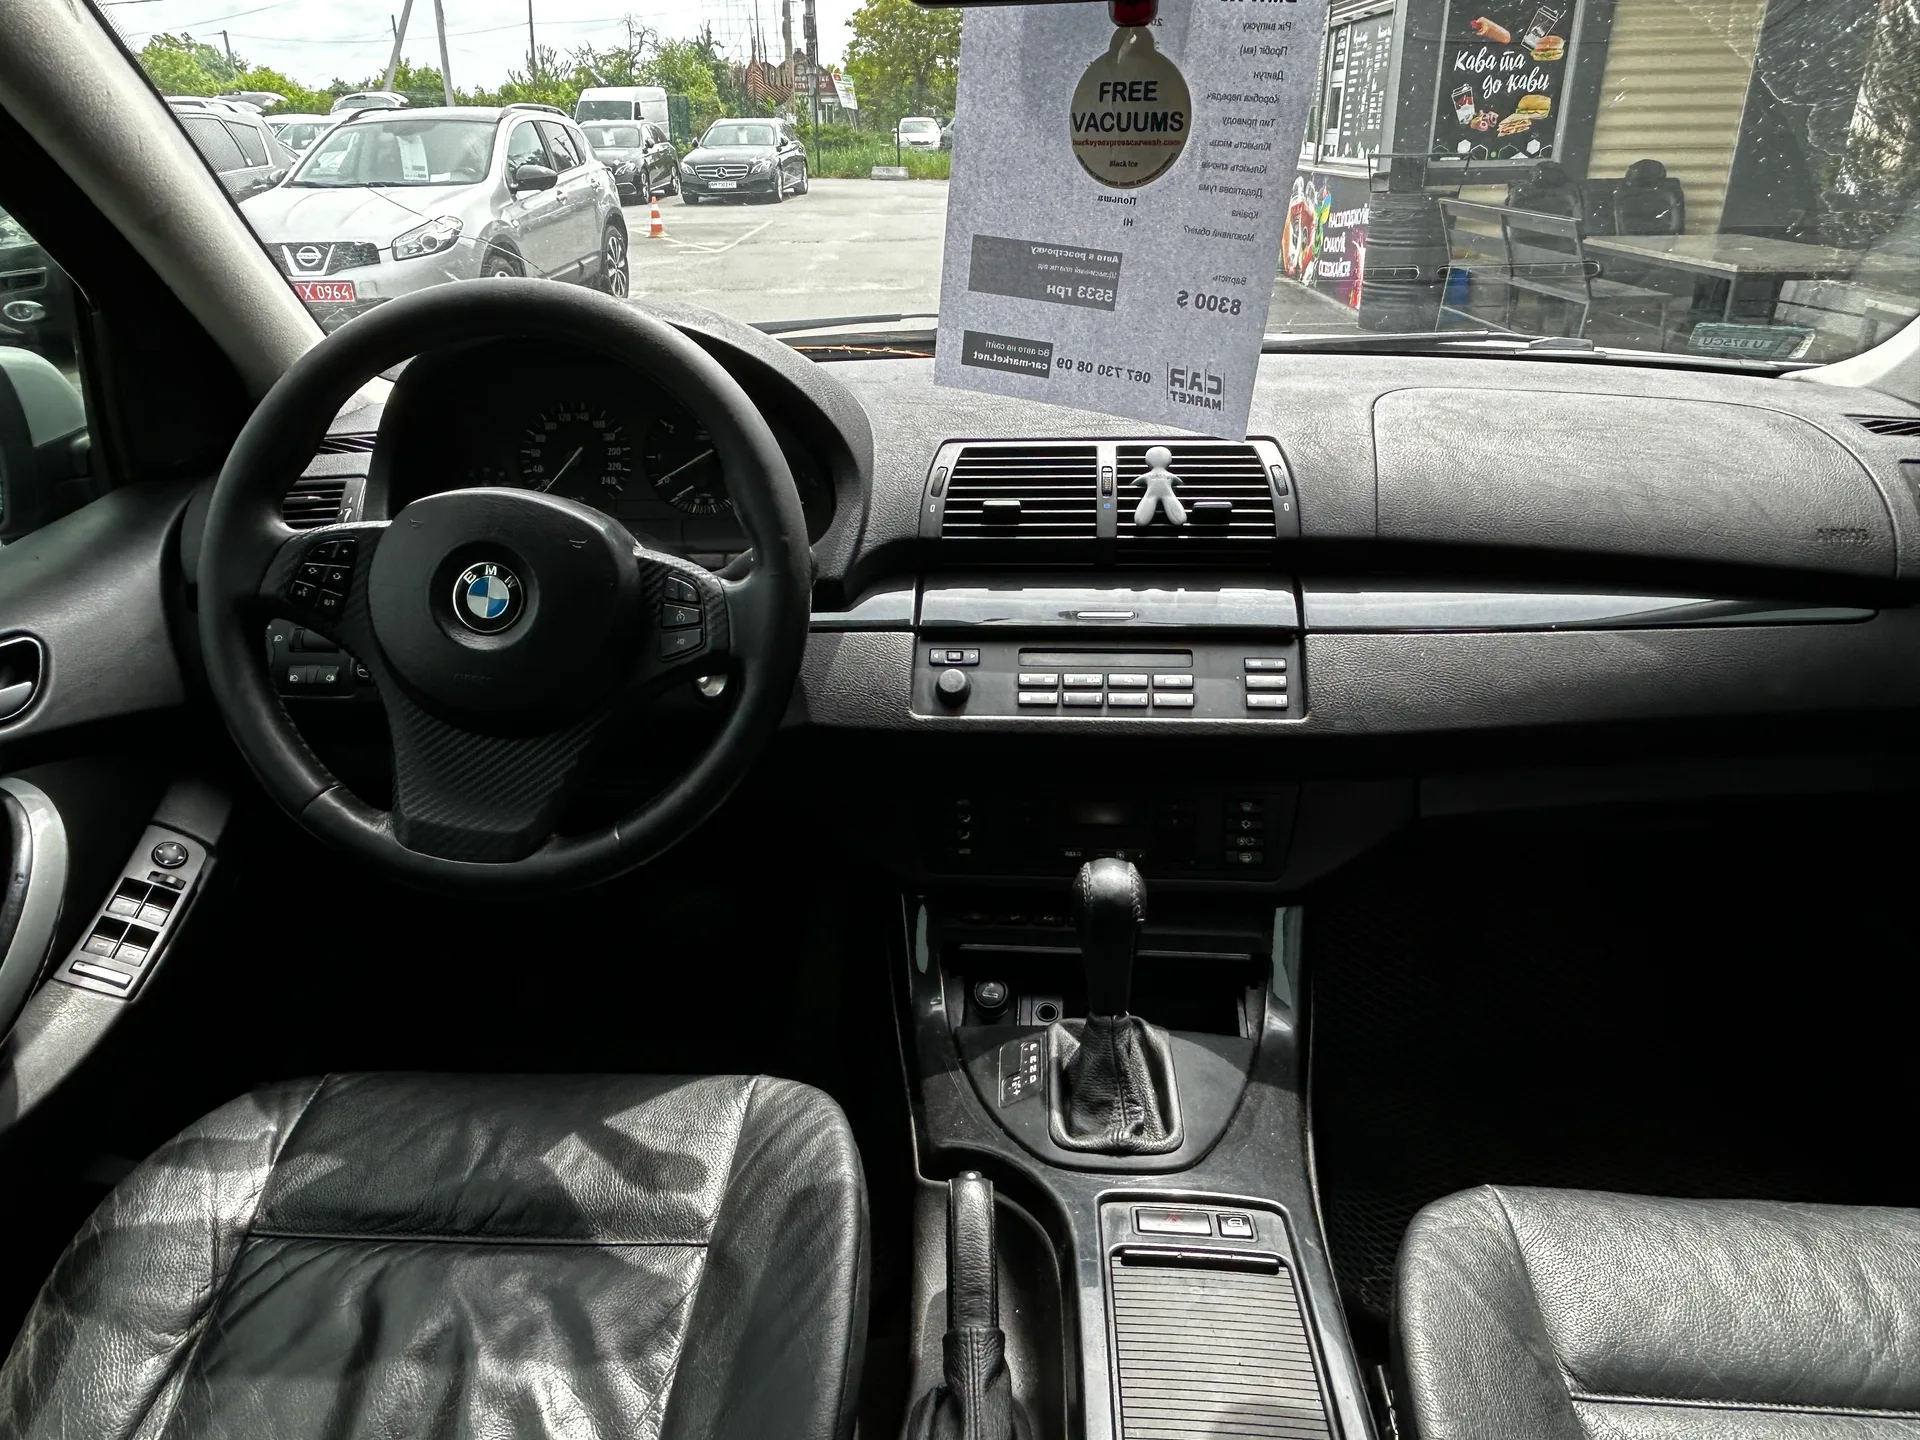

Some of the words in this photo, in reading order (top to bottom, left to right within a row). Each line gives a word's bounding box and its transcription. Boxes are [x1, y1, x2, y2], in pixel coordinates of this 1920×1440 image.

[1453, 47, 1497, 74] Кава
[1481, 72, 1502, 99] до
[1506, 66, 1550, 94] кави
[1099, 81, 1159, 103] FREE
[1071, 111, 1184, 133] VACUUMS
[317, 285, 350, 300] 0964
[463, 564, 518, 589] BMW
[1030, 1043, 1037, 1051] P
[1030, 1055, 1037, 1063] R
[1030, 1064, 1037, 1073] N
[1030, 1075, 1037, 1084] D
